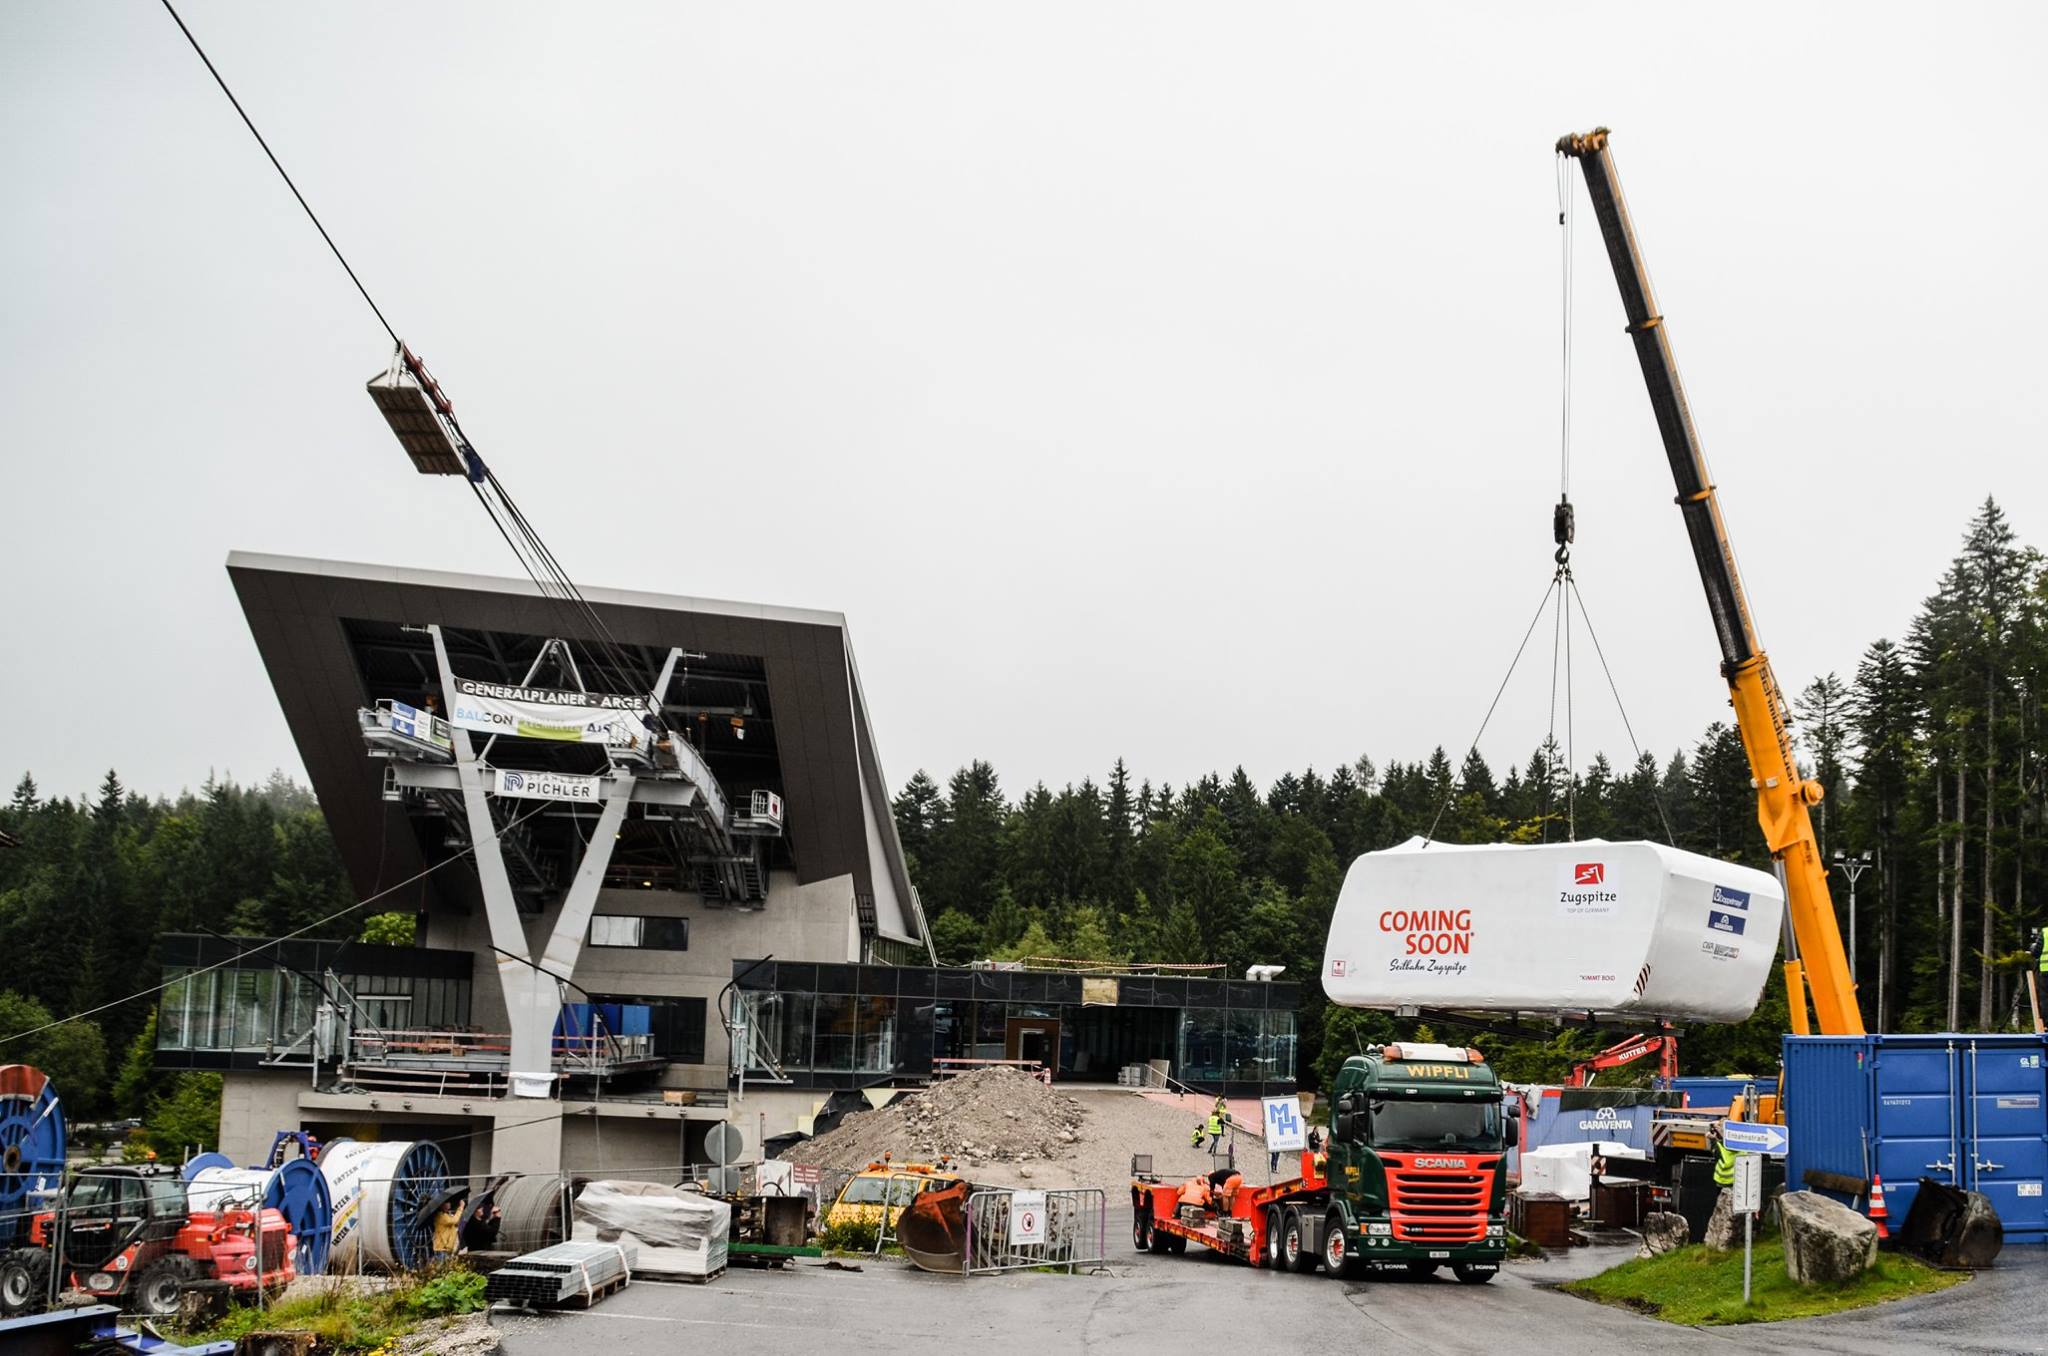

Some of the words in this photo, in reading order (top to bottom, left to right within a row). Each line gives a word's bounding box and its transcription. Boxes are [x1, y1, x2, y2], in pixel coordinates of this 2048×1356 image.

[462, 682, 587, 706] GENERALPLANER
[600, 697, 642, 709] ARGE
[1760, 667, 1795, 785] Schmidbauer
[527, 782, 590, 798] PICHLER
[1560, 890, 1617, 906] Zugspitze
[1379, 909, 1471, 932] COMING
[1389, 958, 1425, 972] Seilbahn
[1427, 959, 1467, 975] Zugspitze
[1619, 1046, 1647, 1061] KUTTER
[1407, 1064, 1470, 1079] WIPFLI
[1579, 1119, 1633, 1131] GARAVENTA
[1414, 1157, 1467, 1169] SCANIA
[333, 1165, 359, 1187] FATZER
[331, 1194, 351, 1216] ATZER
[1475, 1263, 1497, 1271] SCANIA
